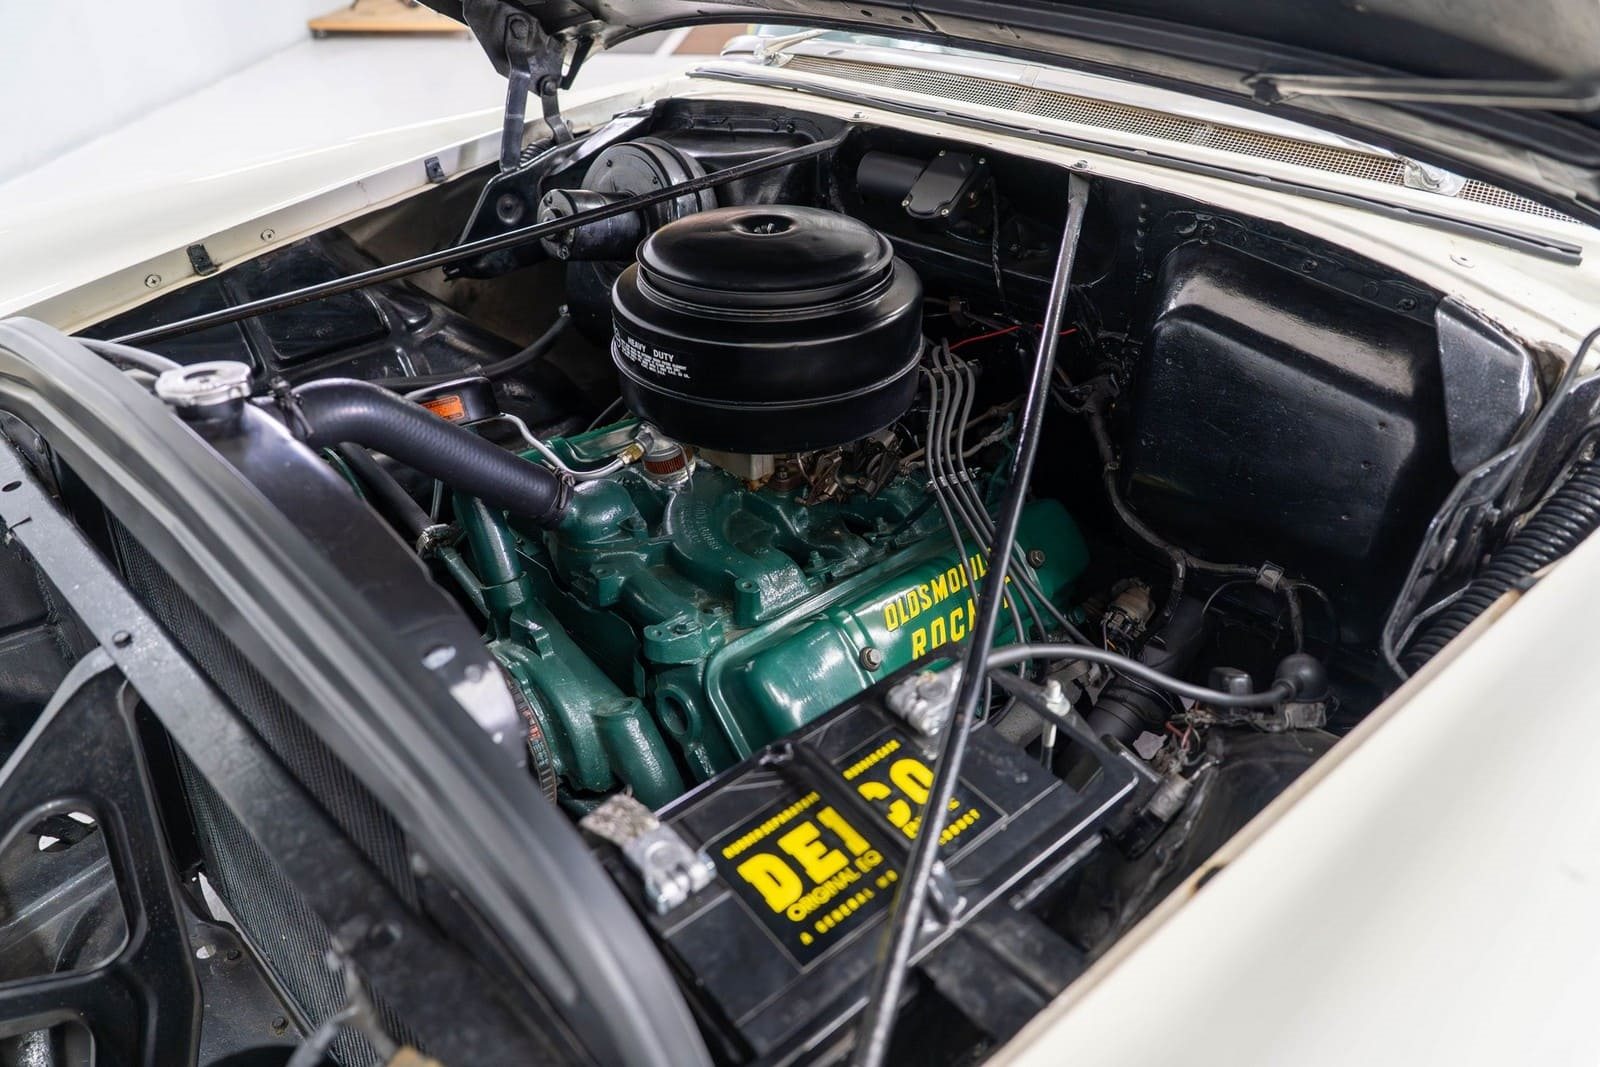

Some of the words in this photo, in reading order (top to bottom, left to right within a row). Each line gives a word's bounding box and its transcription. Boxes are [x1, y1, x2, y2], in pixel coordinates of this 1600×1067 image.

[628, 336, 646, 352] HEAVY
[653, 349, 674, 362] DUTY
[883, 547, 992, 633] OLDSMOIL
